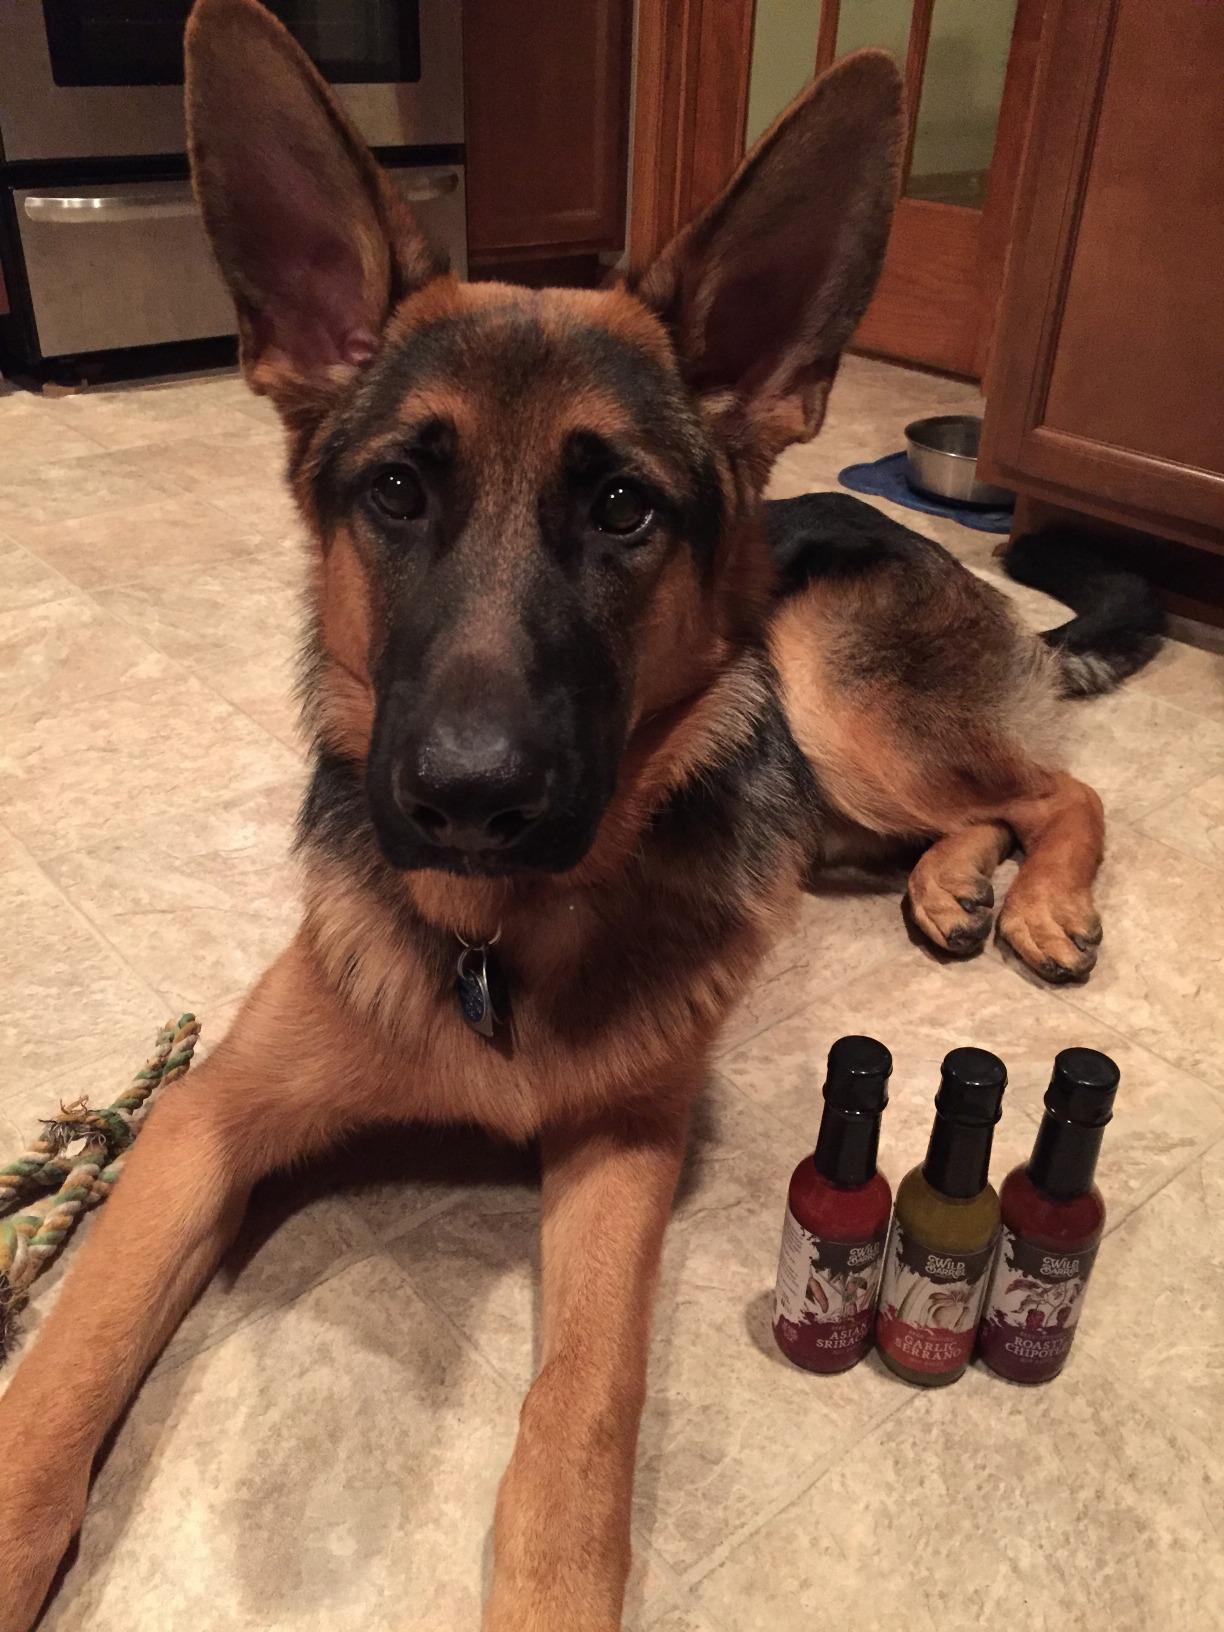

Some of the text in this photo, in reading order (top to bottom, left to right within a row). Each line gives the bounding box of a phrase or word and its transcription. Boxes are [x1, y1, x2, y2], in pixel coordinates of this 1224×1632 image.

[928, 1254, 965, 1270] WILD
[1042, 1256, 1080, 1270] WILD
[895, 1337, 962, 1361] SERRANO
[904, 1334, 958, 1352] GARLIC
